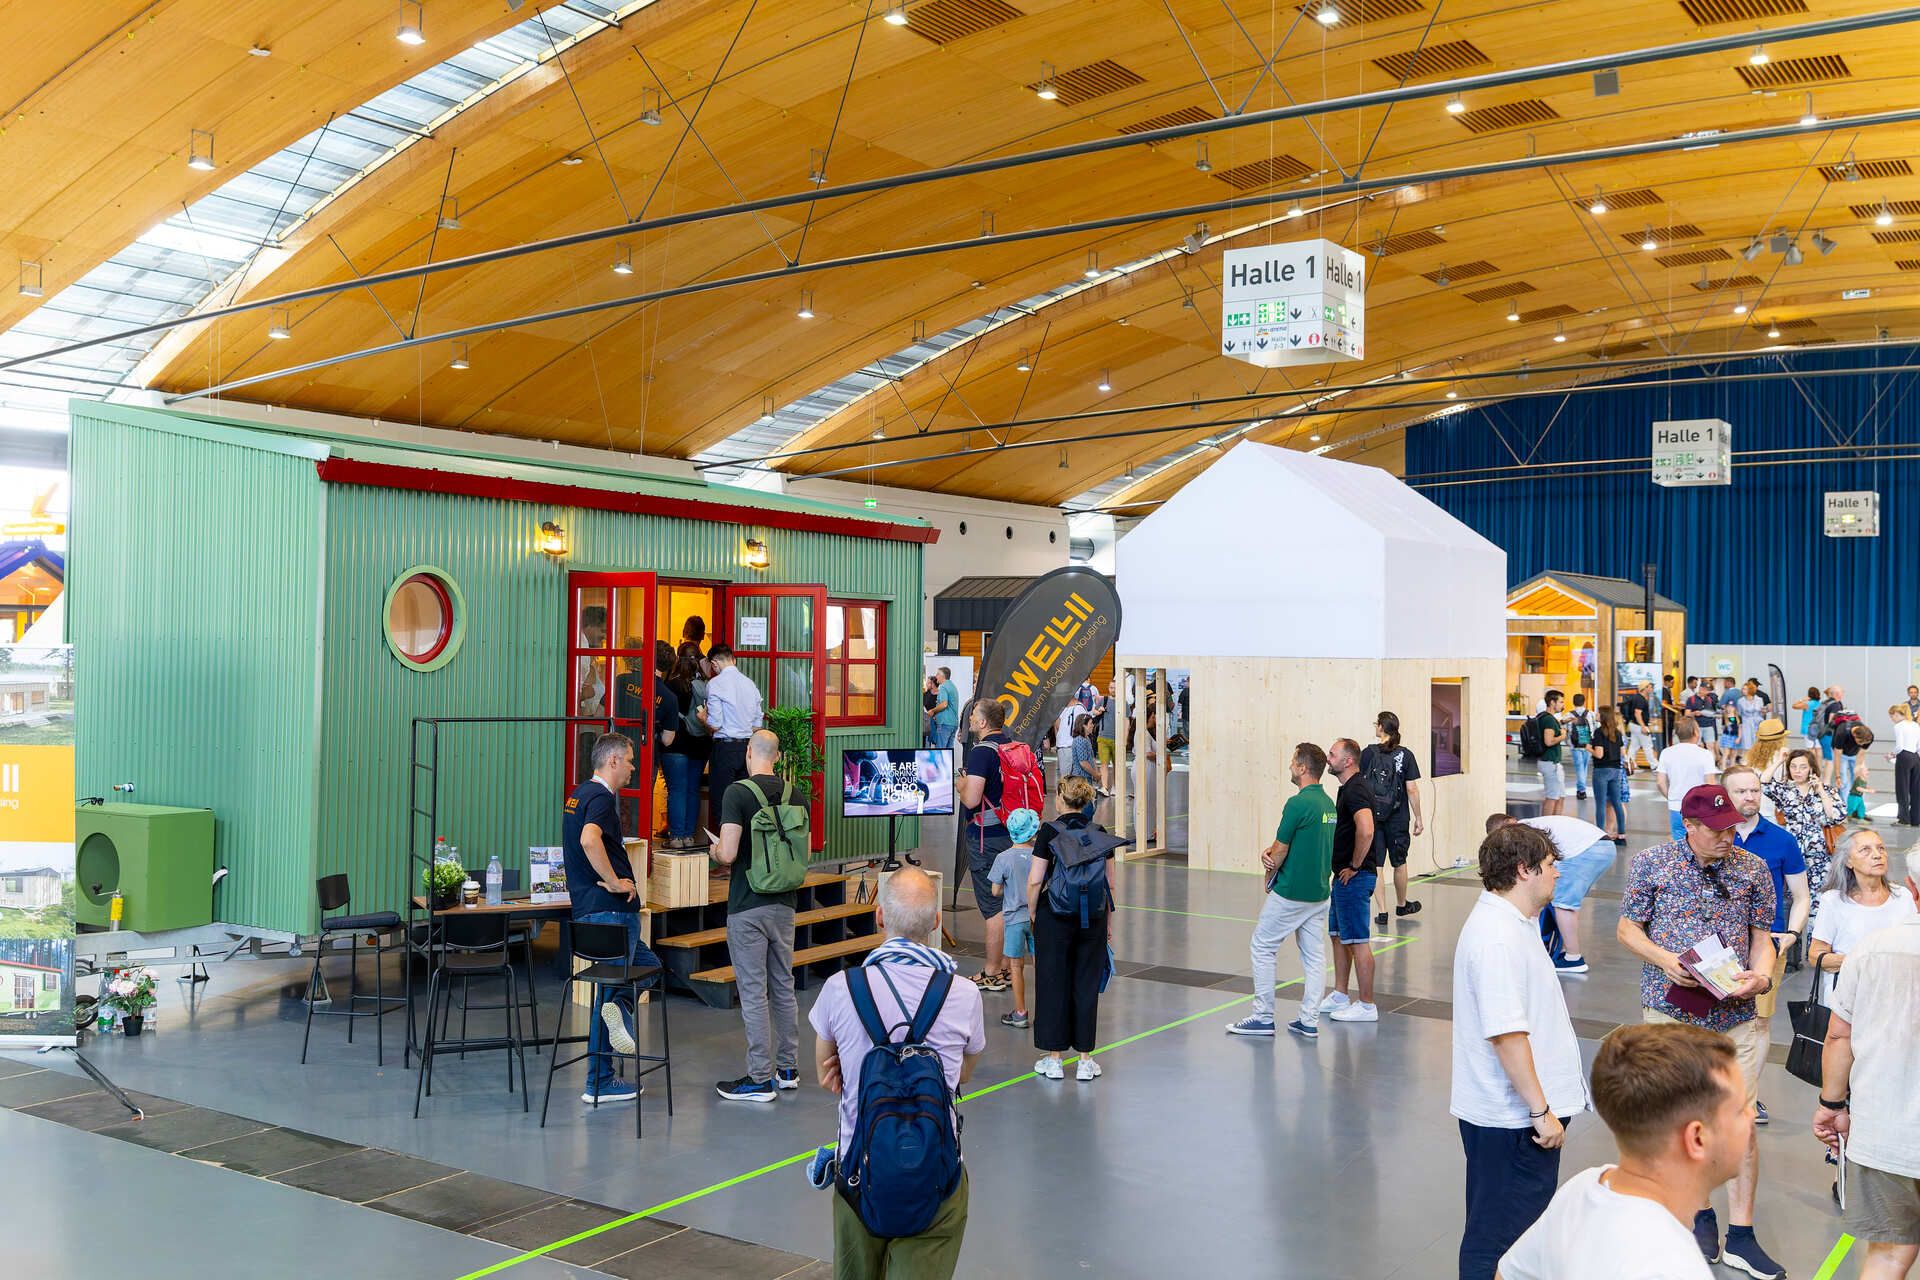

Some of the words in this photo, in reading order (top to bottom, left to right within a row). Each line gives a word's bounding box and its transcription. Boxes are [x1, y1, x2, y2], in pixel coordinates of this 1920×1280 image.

[1231, 259, 1295, 288] Halle
[1305, 255, 1315, 279] 1
[1326, 255, 1354, 289] Halle
[1357, 270, 1362, 293] 1
[1658, 429, 1700, 443] Halle
[1706, 428, 1713, 441] 1
[1828, 498, 1859, 508] Halle
[1864, 497, 1869, 507] 1
[1719, 663, 1731, 671] WC
[1015, 693, 1047, 736] Premium
[1043, 654, 1076, 694] Modular
[1073, 615, 1107, 653] Housing
[881, 762, 897, 771] WE
[899, 762, 918, 771] ARE
[881, 777, 894, 785] ON
[881, 783, 917, 792] MICRO
